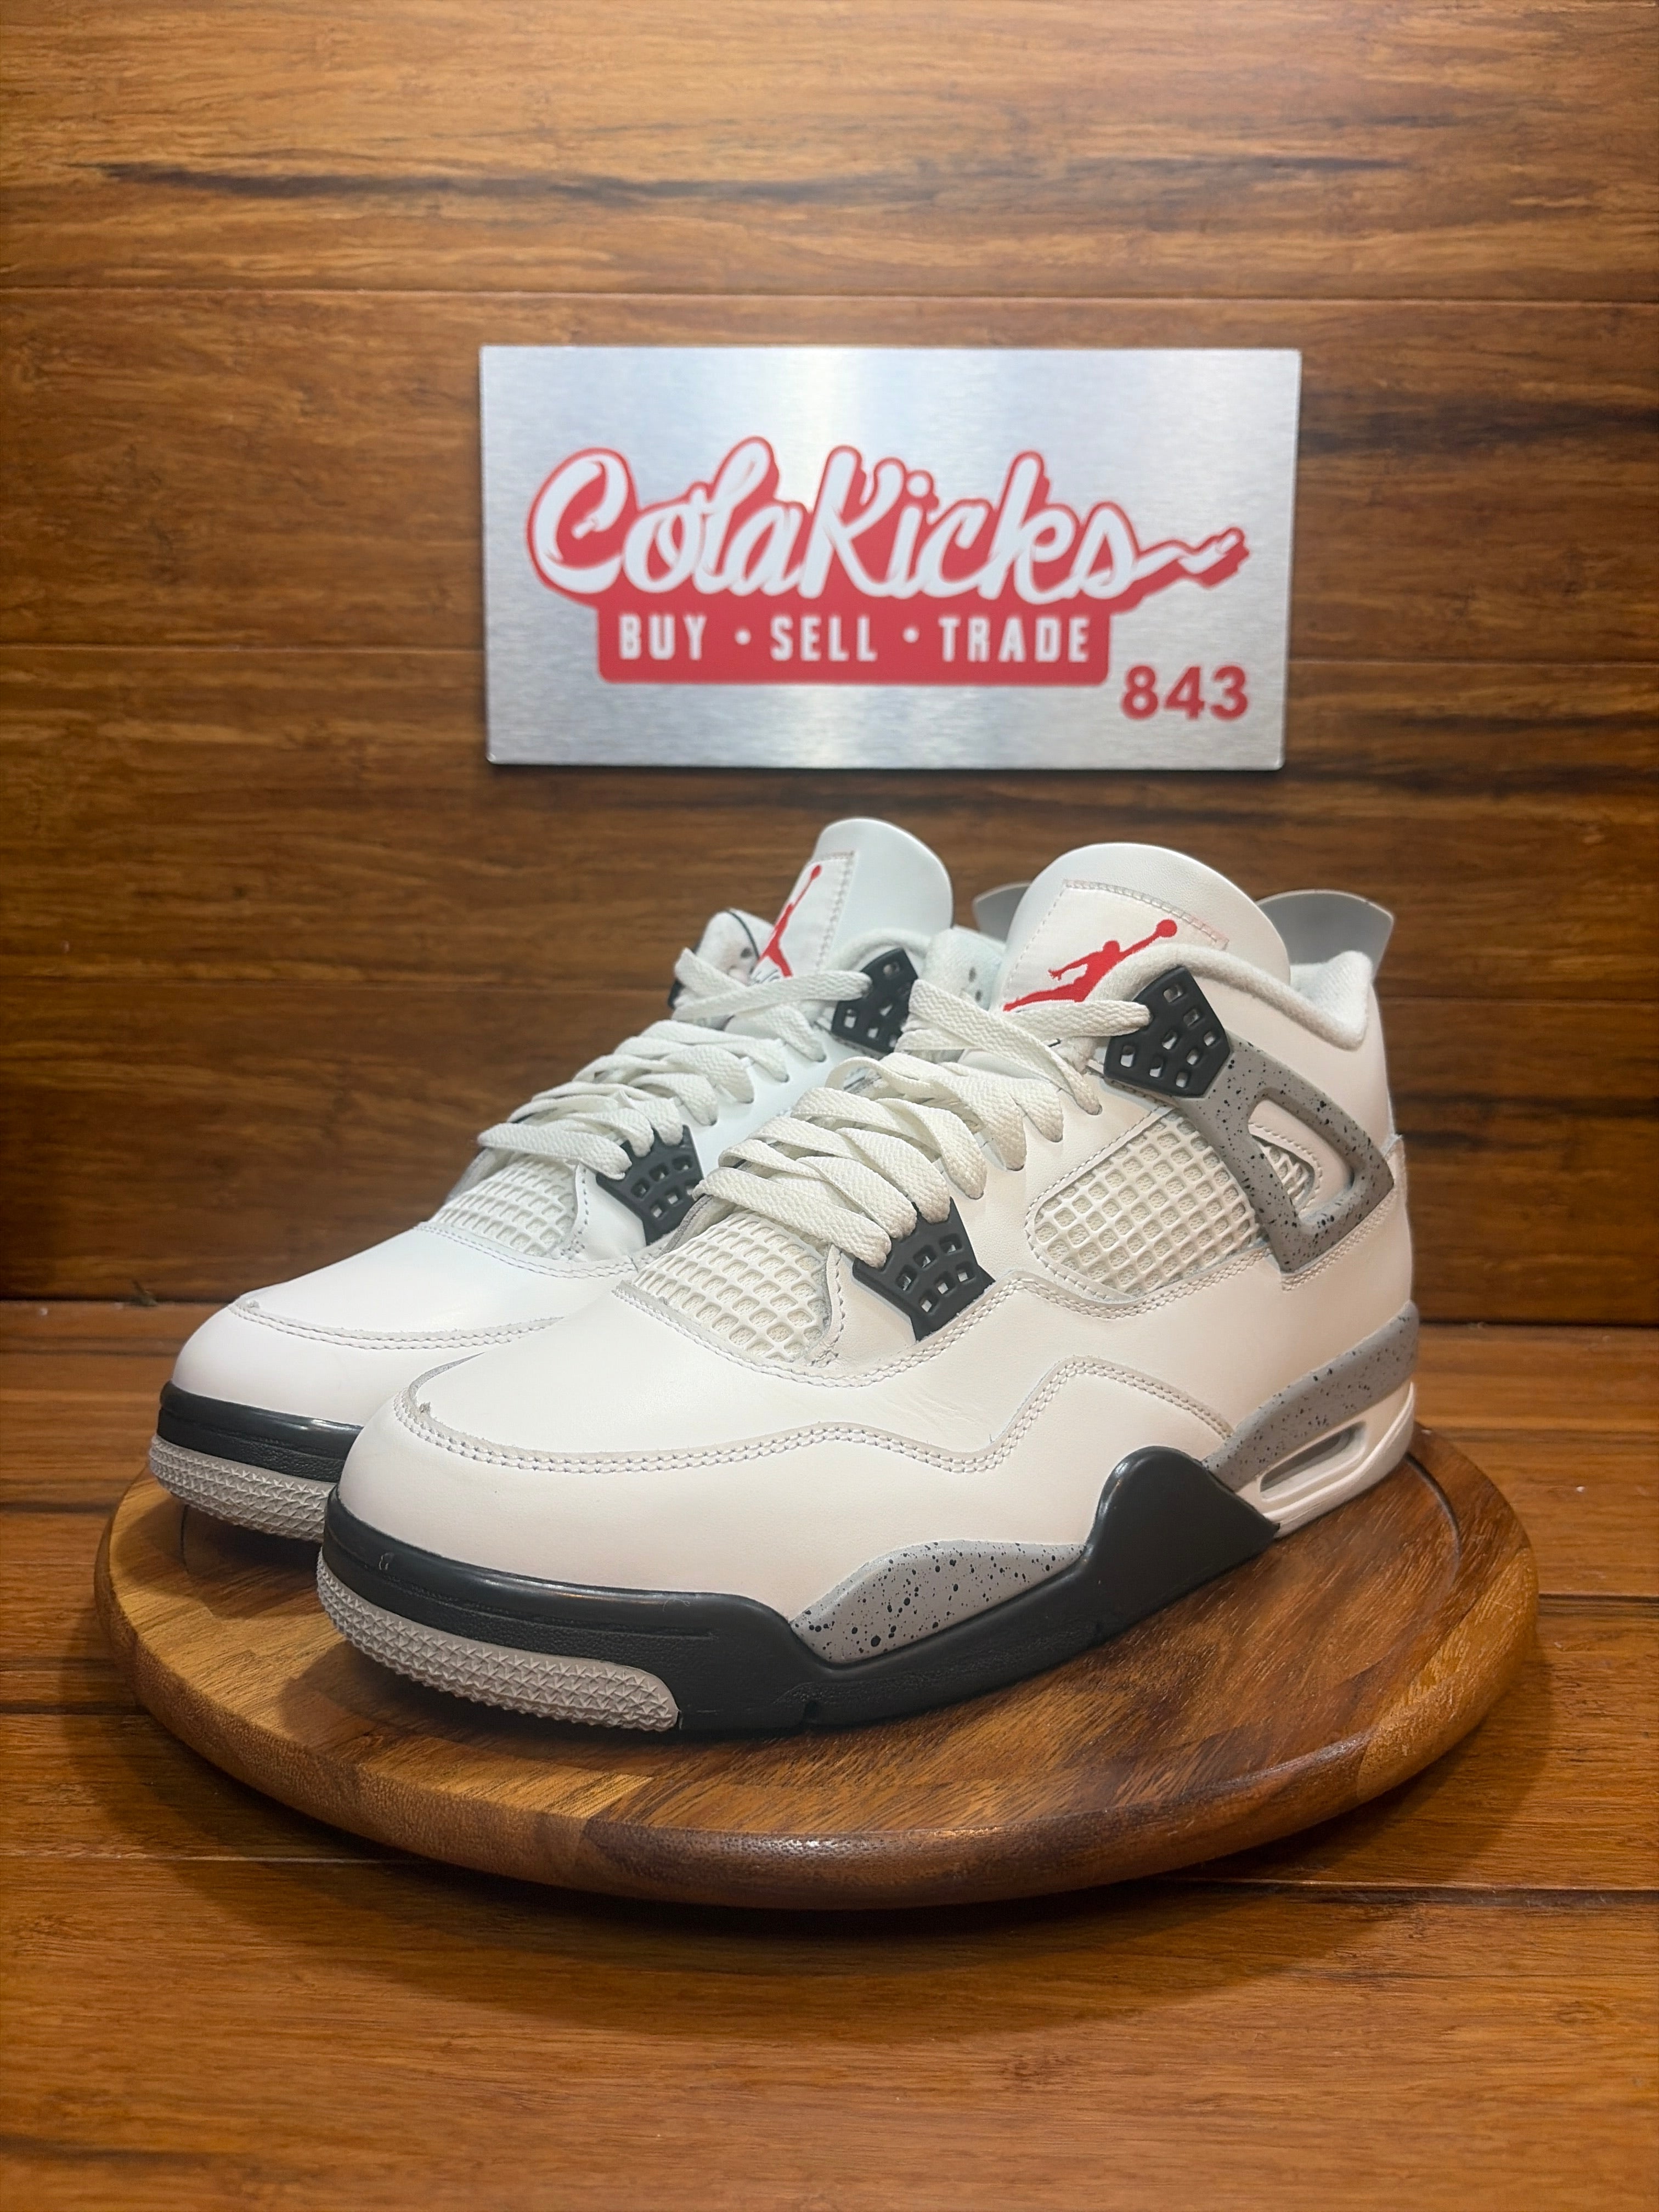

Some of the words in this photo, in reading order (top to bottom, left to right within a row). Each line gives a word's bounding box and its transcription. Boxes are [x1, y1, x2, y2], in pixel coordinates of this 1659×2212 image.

[529, 437, 1249, 605] ColaKicks
[619, 614, 707, 660] BUY
[771, 616, 877, 662] SELL
[939, 617, 1089, 662] TRADE
[1121, 665, 1249, 720] 843
